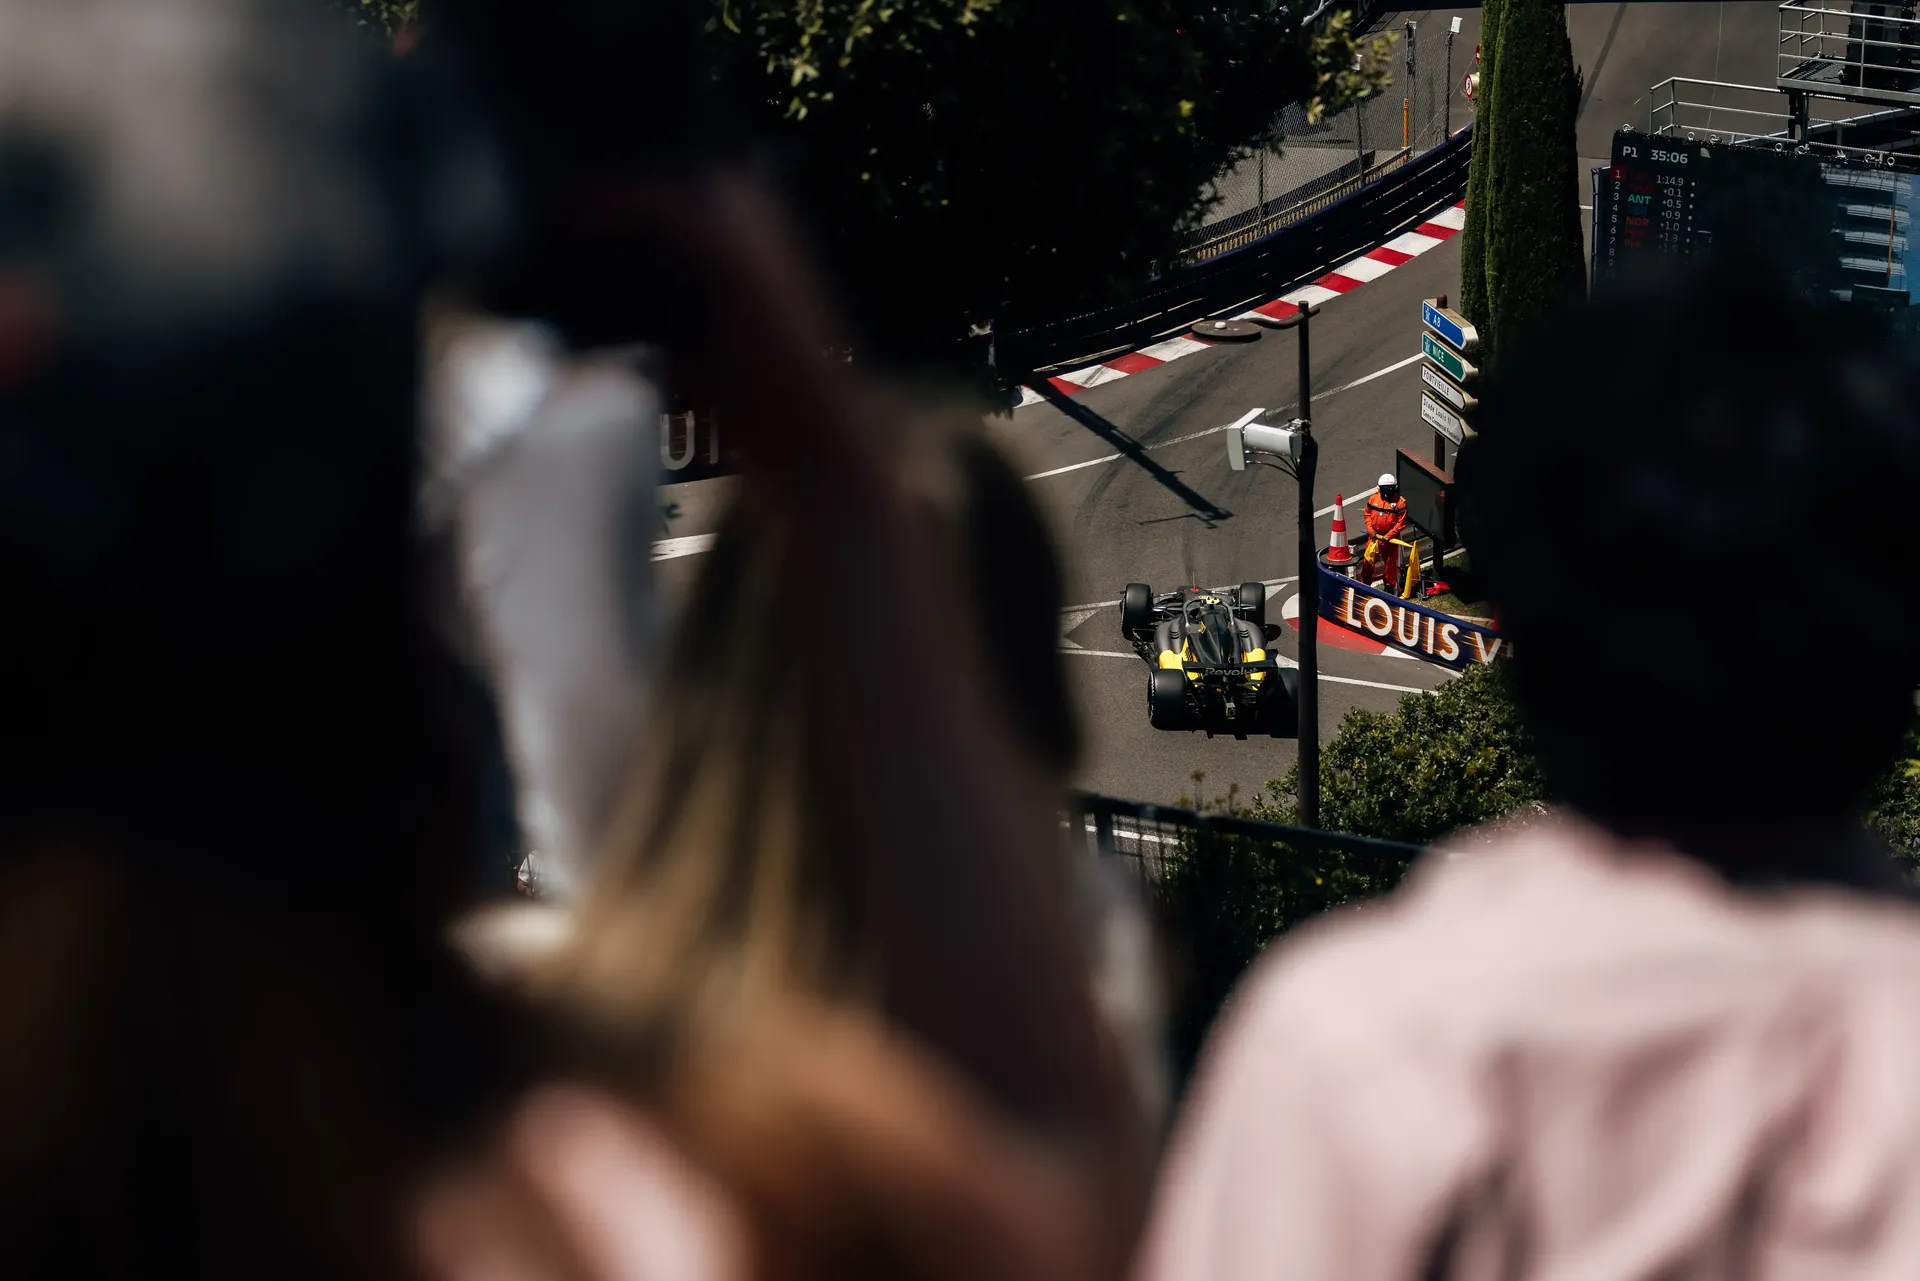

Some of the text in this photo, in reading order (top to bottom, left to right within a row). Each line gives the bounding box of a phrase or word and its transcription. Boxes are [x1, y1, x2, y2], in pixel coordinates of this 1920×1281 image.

[1622, 146, 1688, 164] P1 35:06
[1615, 170, 1621, 178] 1
[1656, 175, 1684, 186] 1:14.9
[1614, 181, 1620, 190] 2
[1664, 187, 1682, 198] +0.1
[1613, 192, 1682, 209] 3 ANT +0.5
[1612, 204, 1618, 212] 4
[1661, 210, 1681, 220] +0.9
[1610, 226, 1616, 234] 6
[1611, 214, 1617, 223] 5
[1660, 221, 1680, 231] +1.0
[1608, 248, 1614, 256] 8
[1433, 315, 1441, 328] A8
[1432, 345, 1445, 363] NICE
[1423, 369, 1450, 396] FONTVIEILLE
[1347, 587, 1460, 661] LOUIS
